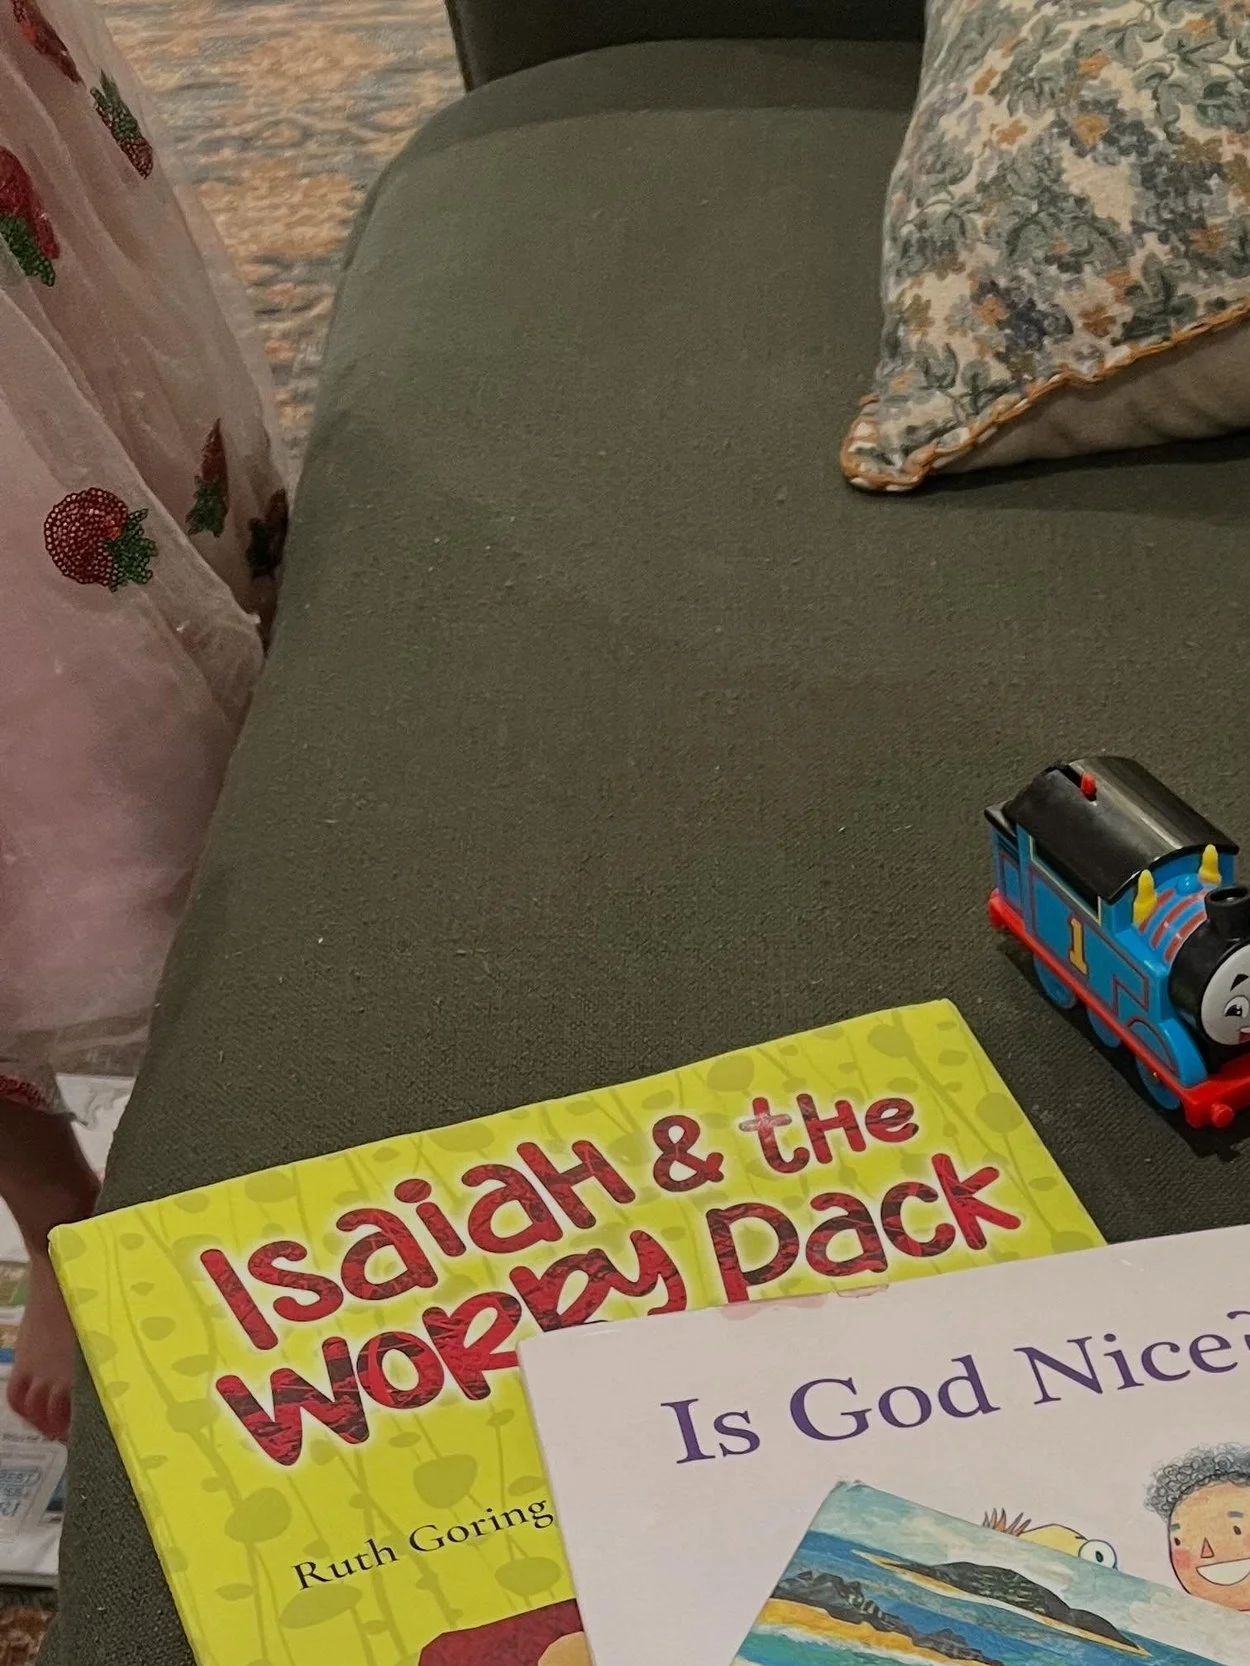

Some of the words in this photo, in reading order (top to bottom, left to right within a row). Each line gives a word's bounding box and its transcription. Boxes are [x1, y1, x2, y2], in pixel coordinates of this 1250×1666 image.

[652, 1114, 724, 1192] &
[661, 1398, 760, 1464] Is
[790, 1354, 1000, 1441] God
[294, 1540, 399, 1590] Ruth
[409, 1500, 554, 1553] Goring
